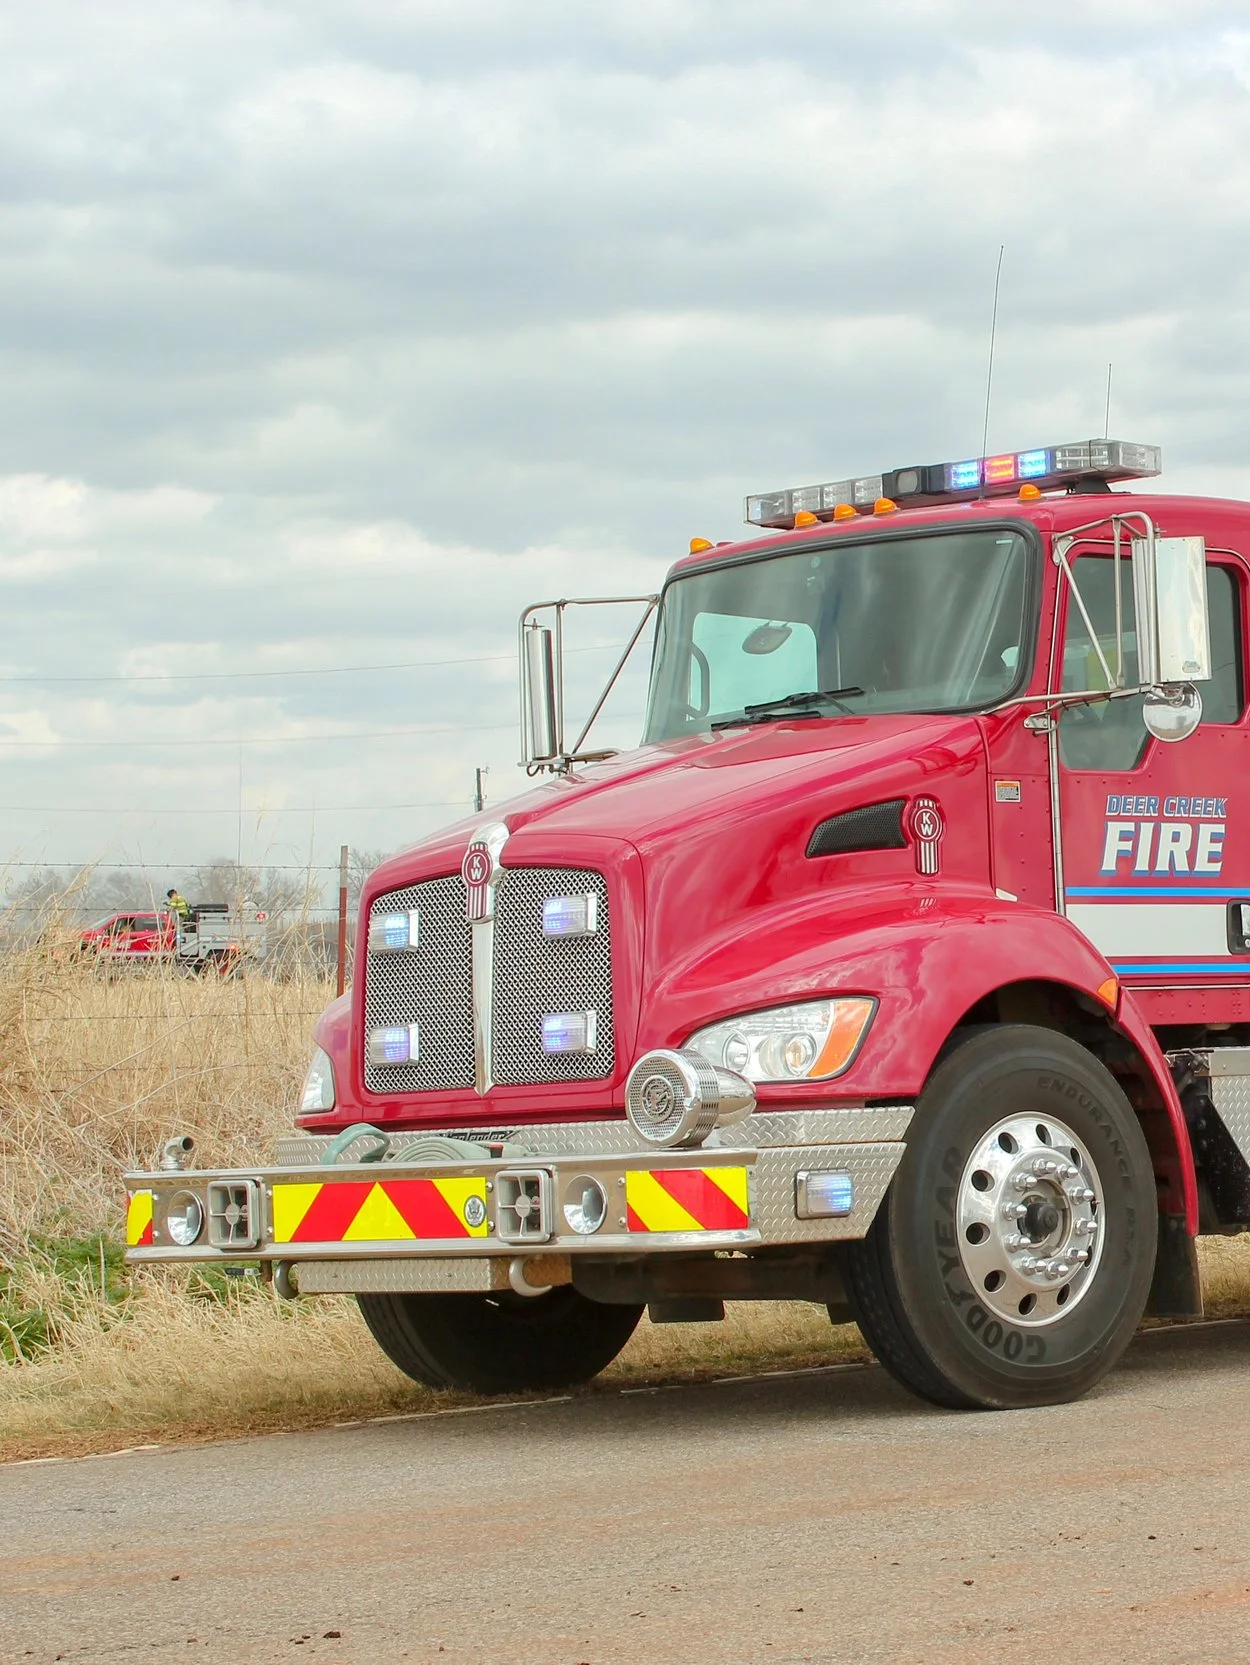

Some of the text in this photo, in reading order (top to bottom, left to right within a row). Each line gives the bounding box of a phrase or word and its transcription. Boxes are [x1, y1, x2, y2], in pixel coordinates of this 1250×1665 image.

[1098, 821, 1226, 878] FIRE
[1105, 795, 1228, 818] DEER CREEK
[1037, 1076, 1132, 1192] ENDURANCE
[935, 1146, 1047, 1362] GOODYEAR
